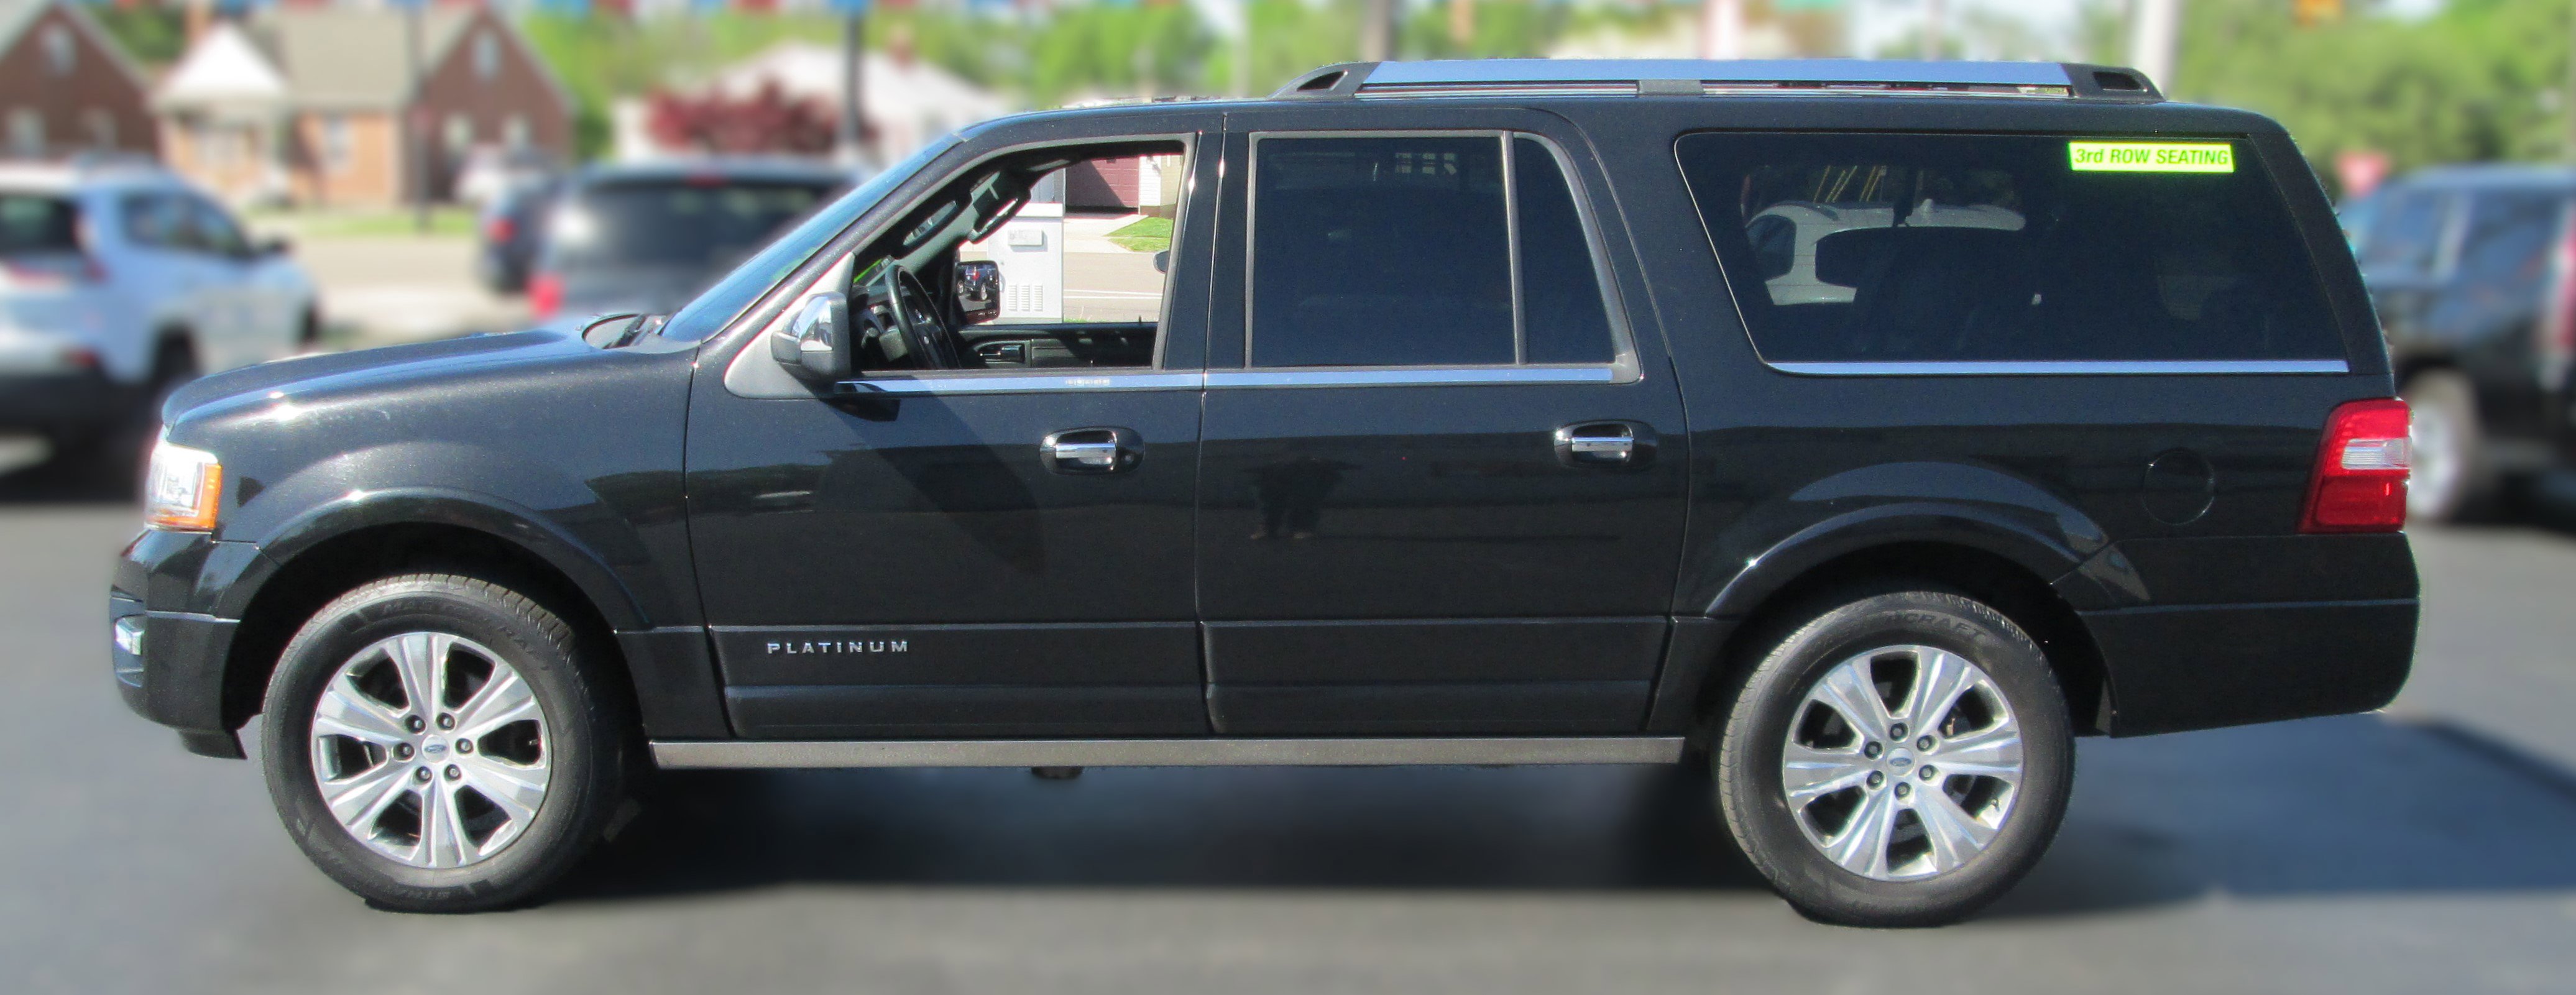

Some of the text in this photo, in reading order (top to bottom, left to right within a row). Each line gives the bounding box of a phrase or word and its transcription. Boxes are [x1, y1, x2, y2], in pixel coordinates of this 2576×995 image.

[2074, 149, 2229, 165] 3rd ROW SEATING
[766, 641, 908, 654] PLATINUM
